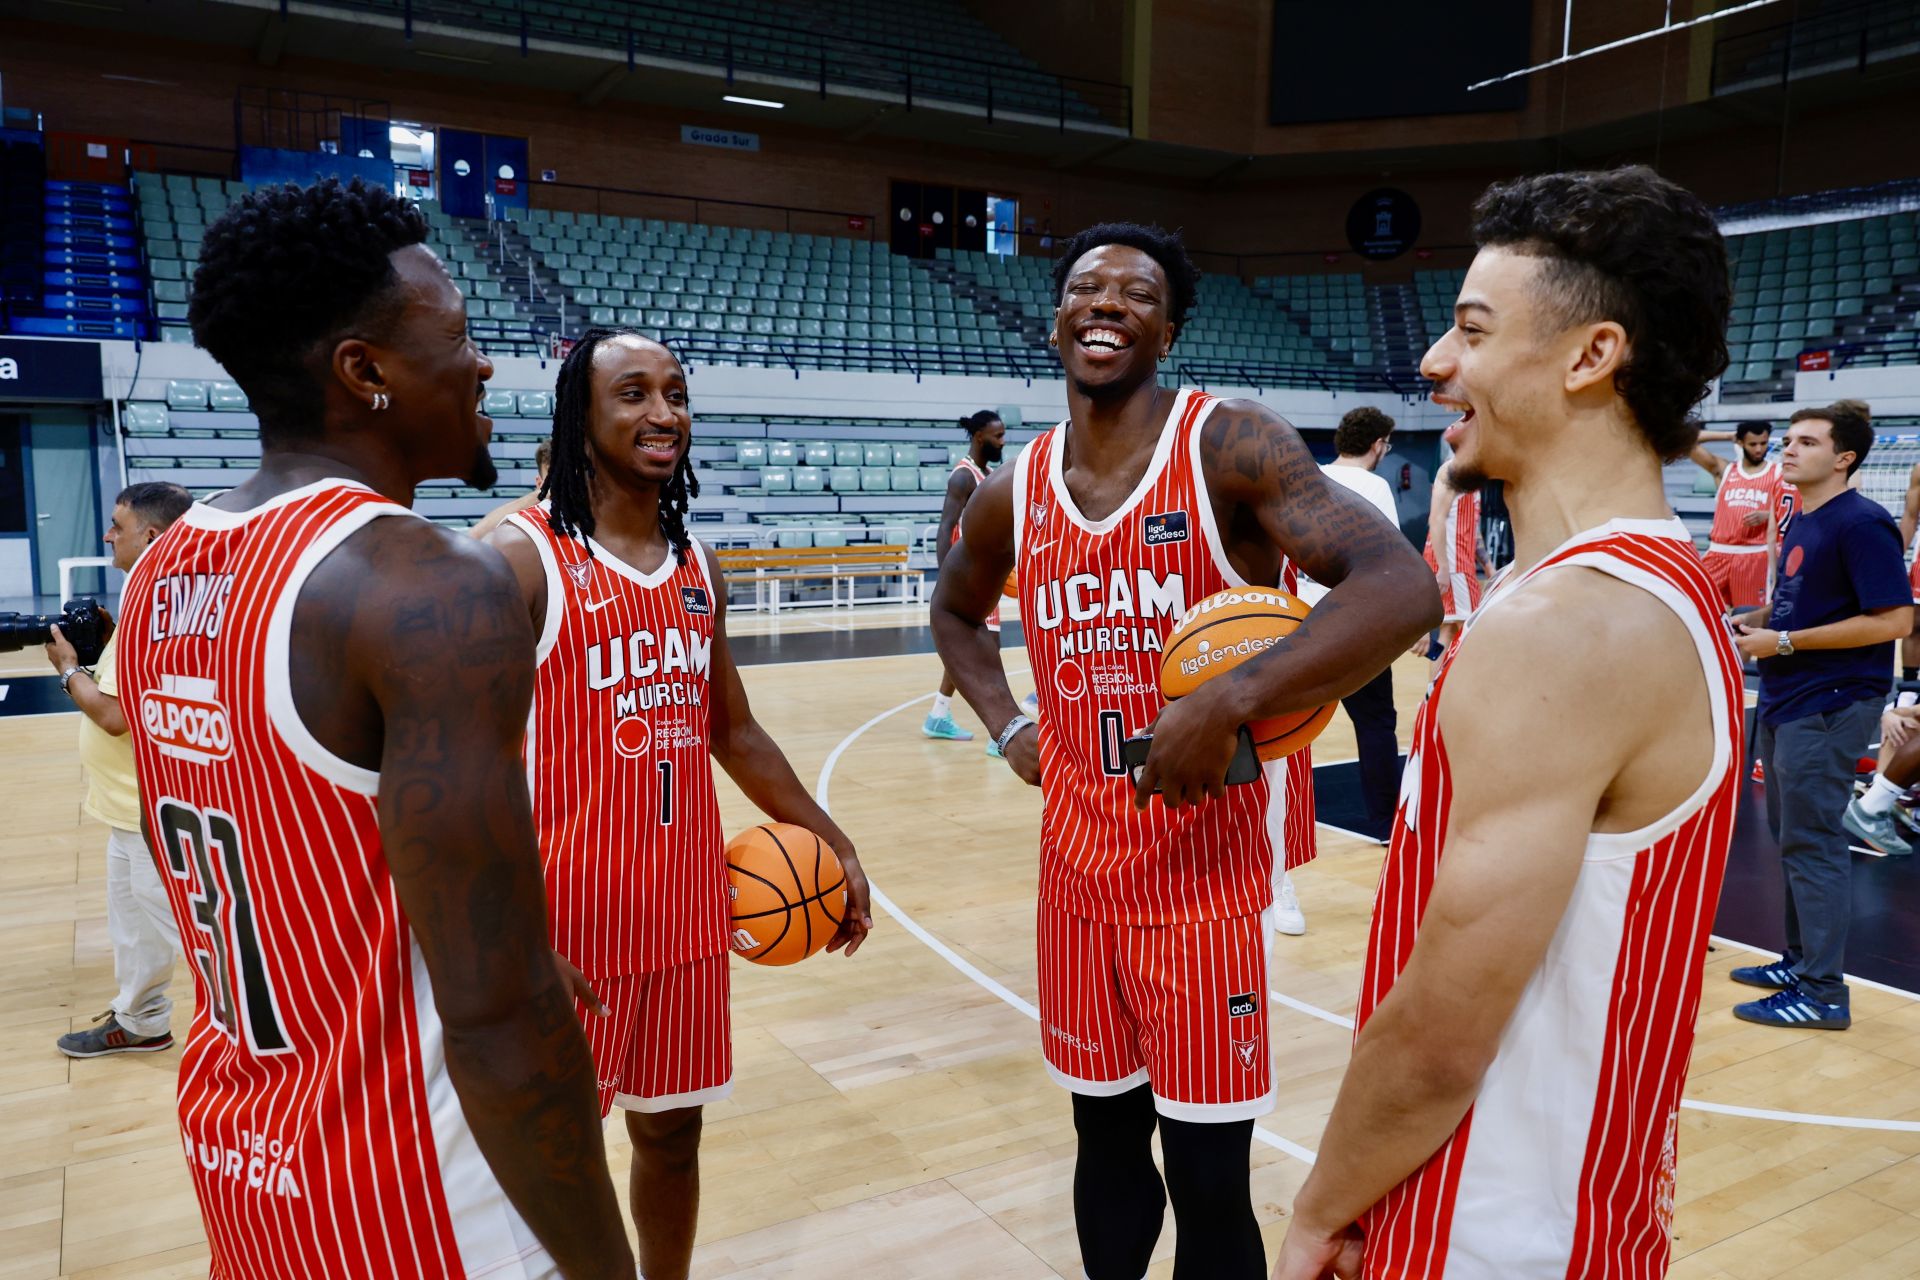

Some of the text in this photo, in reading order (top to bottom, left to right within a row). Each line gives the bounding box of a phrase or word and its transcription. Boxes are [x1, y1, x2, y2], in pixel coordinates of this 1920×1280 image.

[690, 130, 750, 146] Grada Sur
[1724, 488, 1769, 505] UCAM
[1148, 524, 1165, 534] liga
[1148, 530, 1186, 542] endesa
[151, 572, 235, 642] ENNIS
[684, 594, 696, 604] liga
[1037, 568, 1187, 632] UCAM
[1060, 626, 1164, 660] MURCIA
[587, 627, 712, 691] UCAM
[1180, 653, 1210, 676] liga
[616, 681, 702, 719] MURCIA
[1095, 682, 1158, 695] DE MURCIA
[657, 740, 670, 750] DE
[1099, 709, 1129, 777] 0
[658, 760, 673, 826] 1
[156, 796, 297, 1057] 31
[1231, 1002, 1253, 1015] acb
